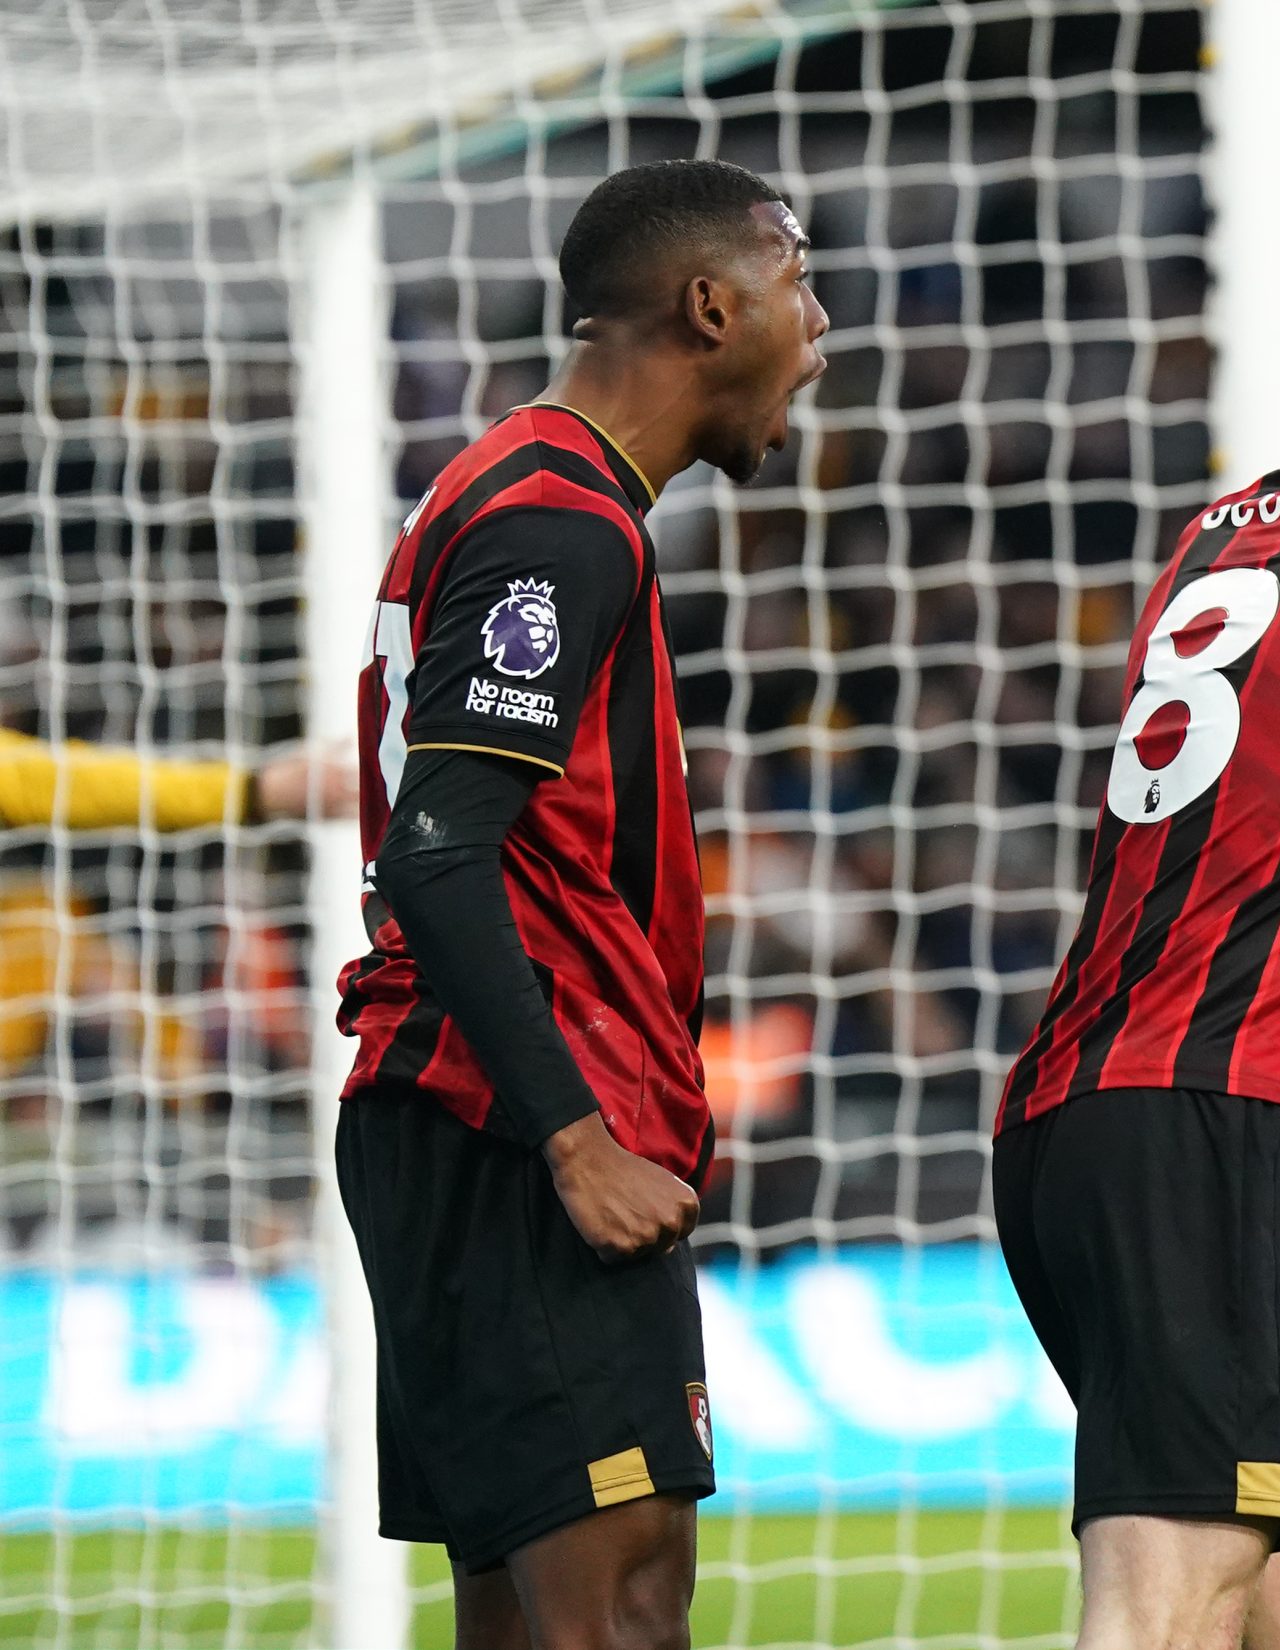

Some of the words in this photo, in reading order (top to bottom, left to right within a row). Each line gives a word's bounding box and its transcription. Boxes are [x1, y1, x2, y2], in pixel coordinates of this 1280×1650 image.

[465, 694, 496, 714] for
[495, 701, 559, 728] racism
[469, 676, 500, 699] No
[500, 686, 556, 711] room
[1107, 567, 1280, 825] 8
